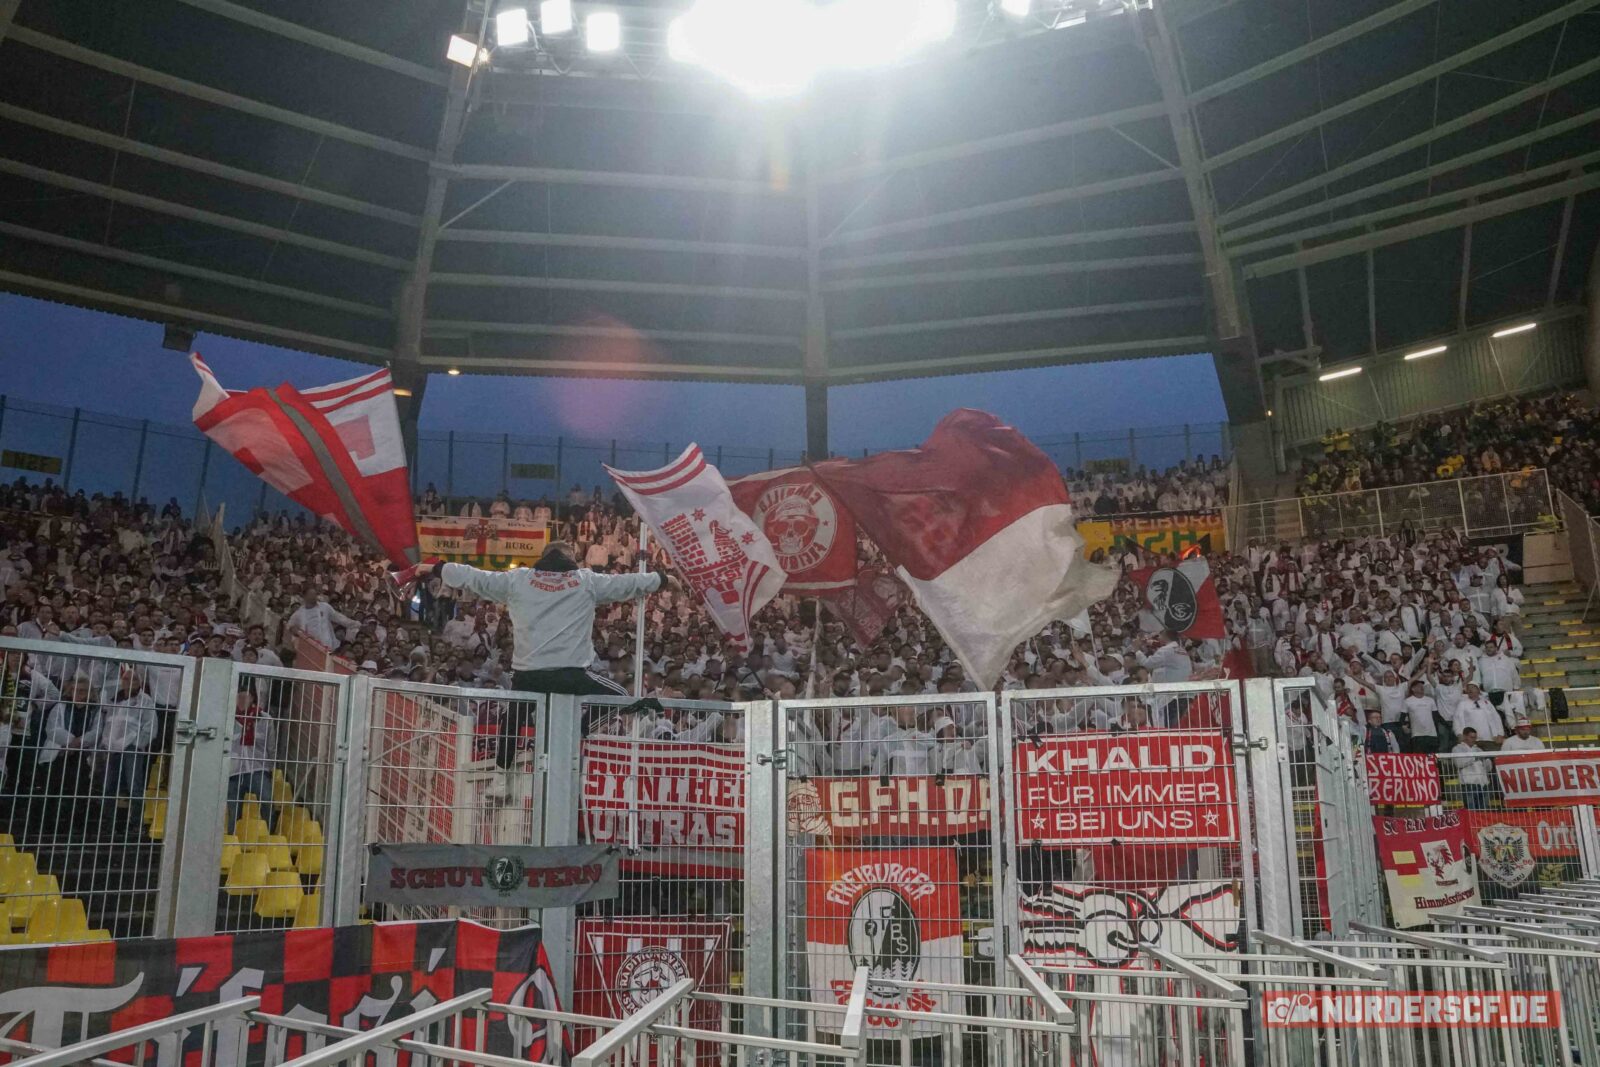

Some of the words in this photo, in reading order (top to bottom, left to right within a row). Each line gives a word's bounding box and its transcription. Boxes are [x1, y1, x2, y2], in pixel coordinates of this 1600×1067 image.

[1027, 744, 1217, 777] KHALID
[1366, 754, 1437, 777] SEZIONE
[1368, 778, 1439, 801] BERLINO
[1500, 764, 1600, 793] NIEDER
[1028, 781, 1095, 806] FÜR
[1106, 781, 1221, 804] IMMER
[590, 806, 737, 848] ULTRAS
[1055, 811, 1107, 831] BEI
[1117, 809, 1195, 831] UNS
[826, 863, 936, 906] FREIBURGER
